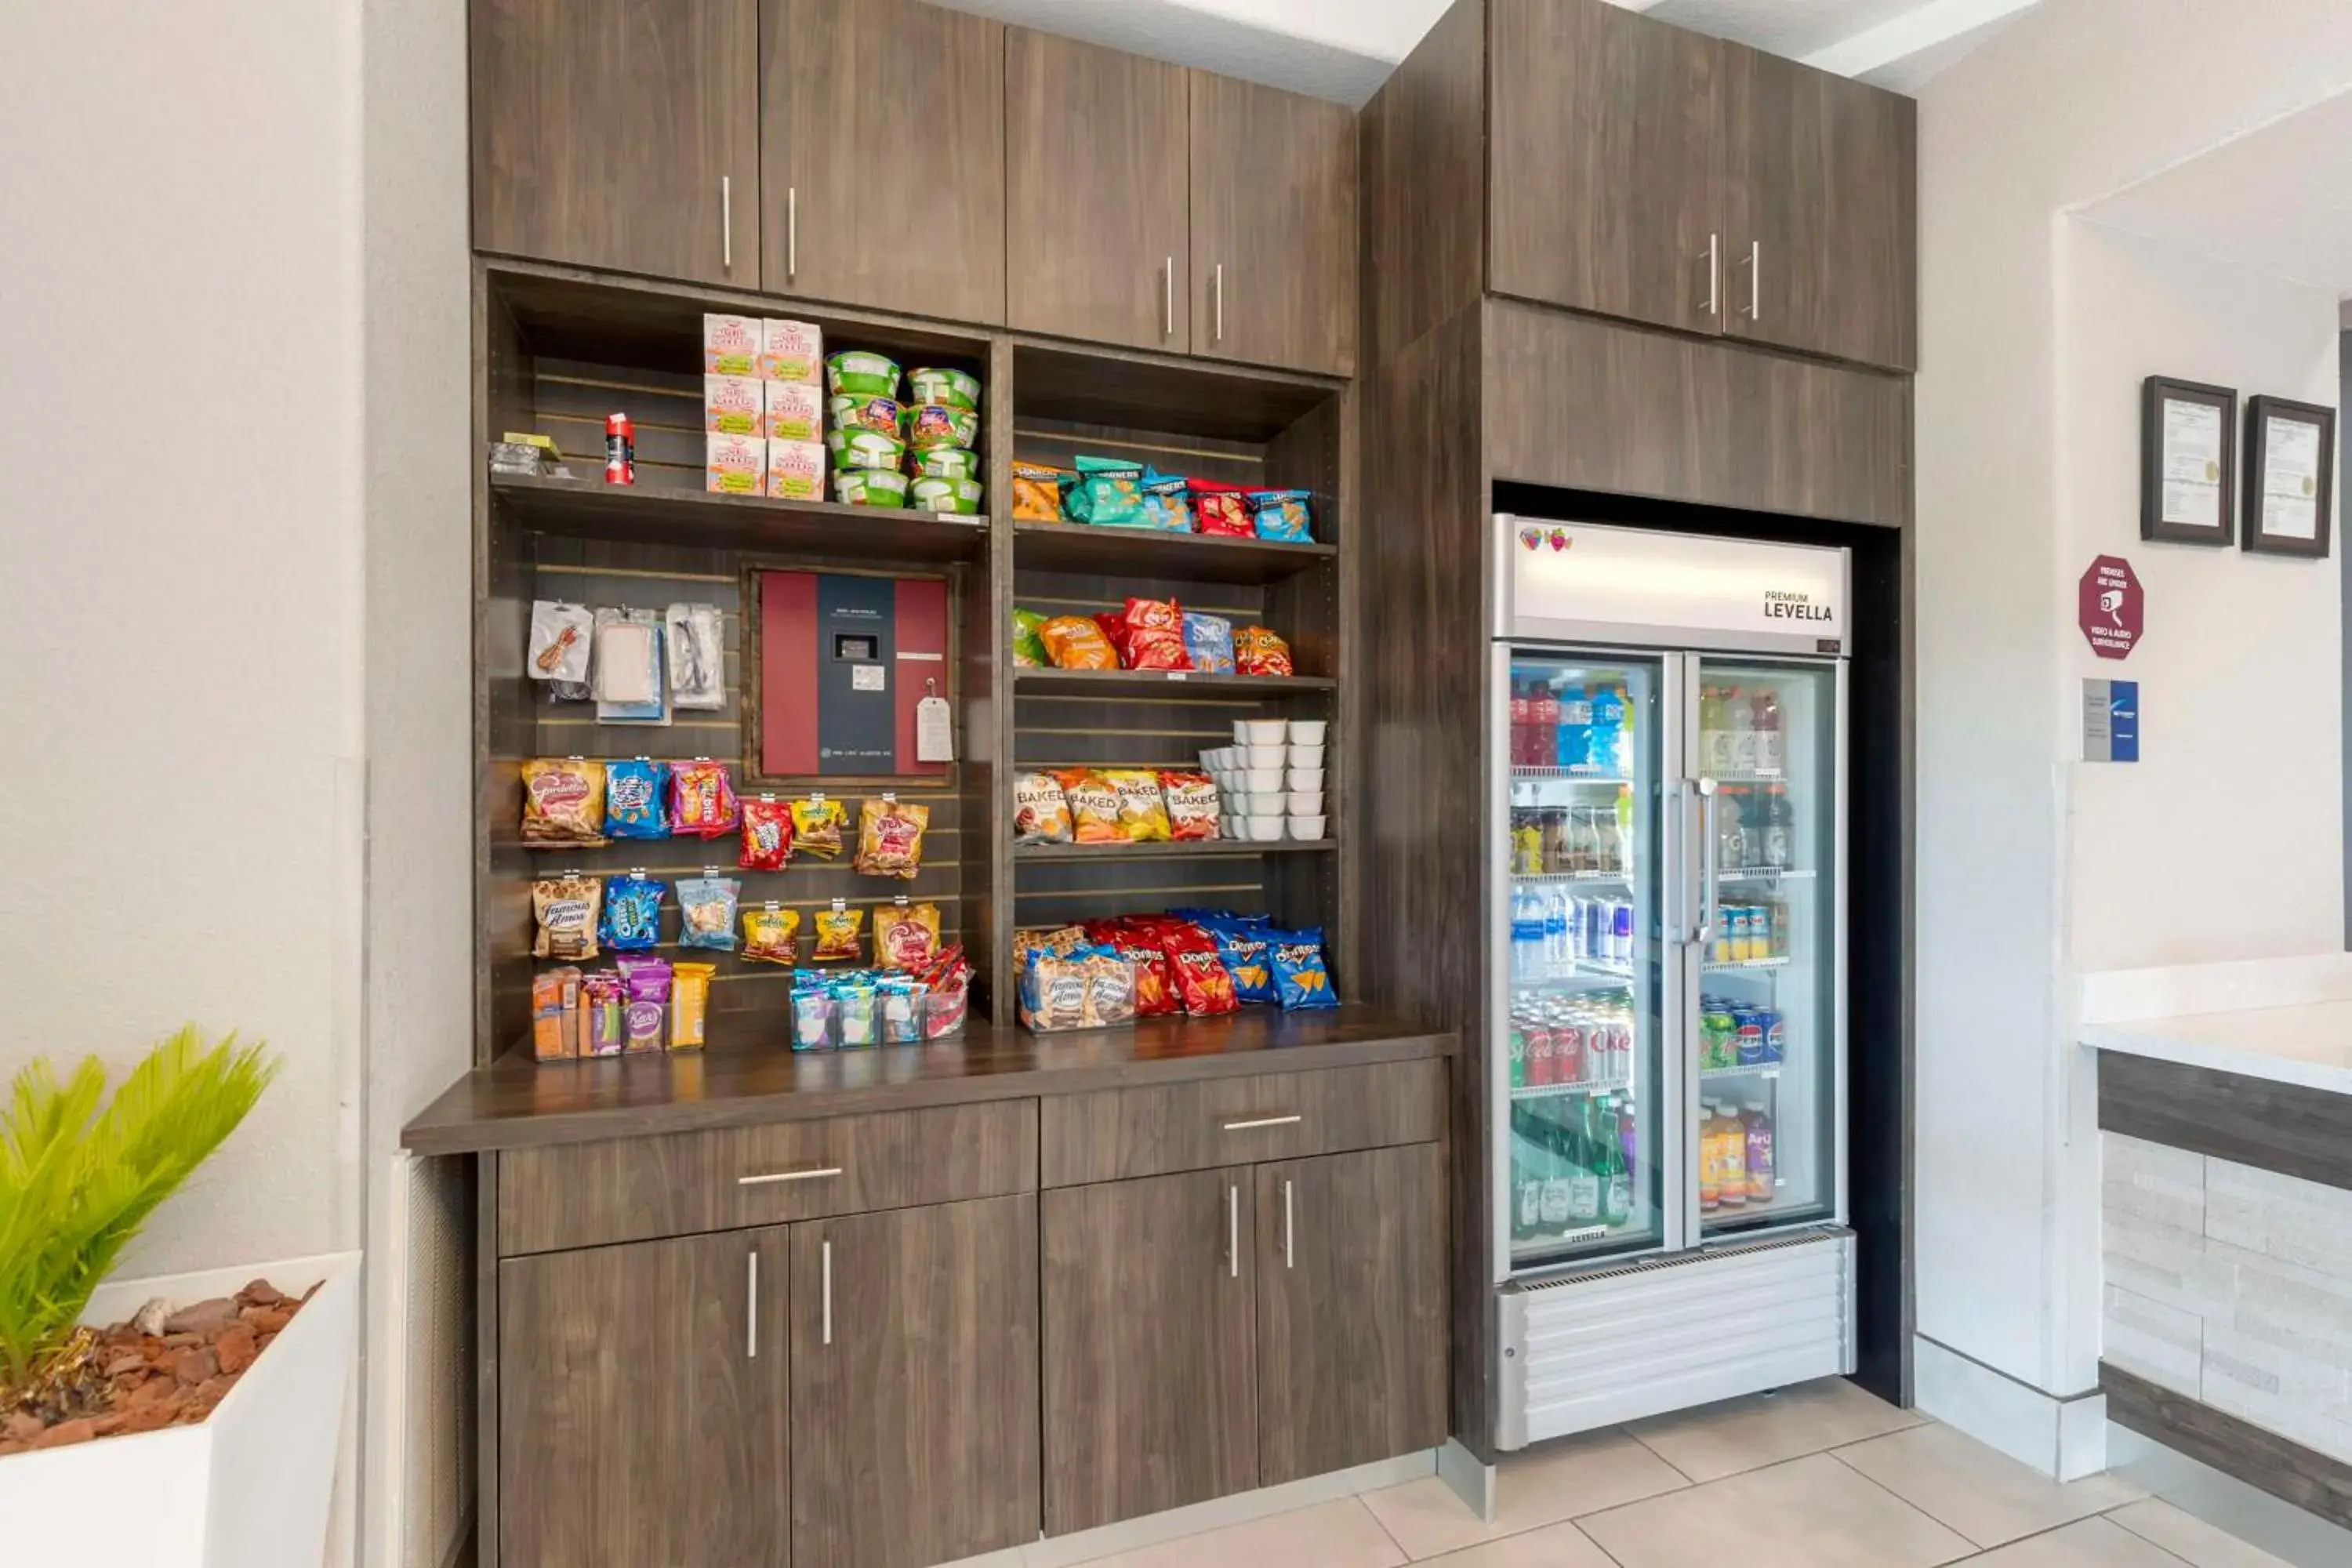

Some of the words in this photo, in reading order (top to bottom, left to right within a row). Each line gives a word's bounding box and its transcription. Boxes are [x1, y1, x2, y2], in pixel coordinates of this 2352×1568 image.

[1764, 590, 1808, 603] PREMIUM
[1764, 601, 1832, 622] LEVELLA
[2091, 626, 2108, 637] VIDEO
[2113, 630, 2132, 639] AUDIO
[1018, 789, 1065, 803] BAKED
[1117, 786, 1158, 797] BAKED
[1070, 793, 1116, 808] BAKED
[542, 902, 590, 921] Famous
[549, 913, 585, 926] Amos
[1276, 944, 1321, 962] Doritos
